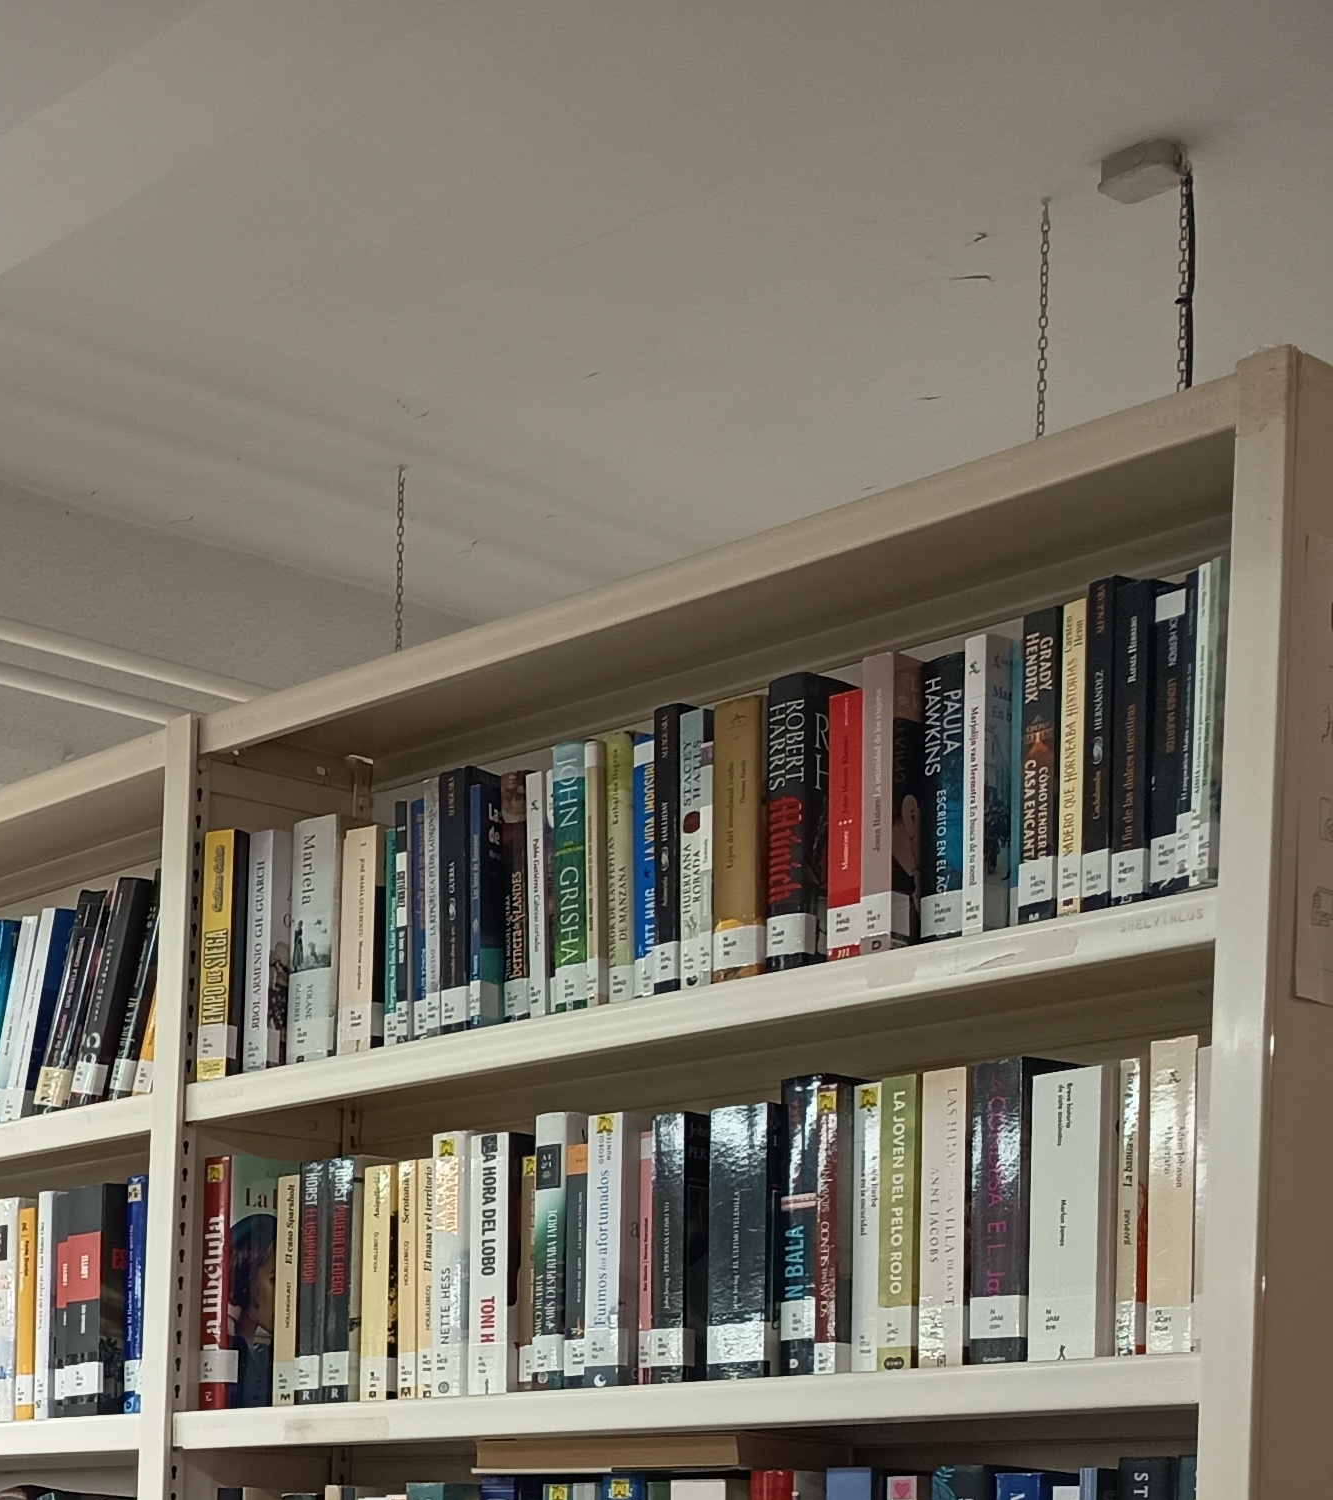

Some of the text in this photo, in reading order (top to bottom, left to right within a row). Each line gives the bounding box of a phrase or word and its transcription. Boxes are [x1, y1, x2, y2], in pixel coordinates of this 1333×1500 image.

[1026, 632, 1039, 704] HENDRIX
[1038, 636, 1053, 690] GRADY
[769, 703, 786, 791] HARRIS
[785, 699, 805, 782] ROBERT
[924, 677, 942, 776] HAWKINS
[943, 689, 962, 755] PAULA
[555, 757, 580, 964] JOHN GRISHA
[889, 1090, 906, 1295] LA JOVEN DEL PELO ROJO
